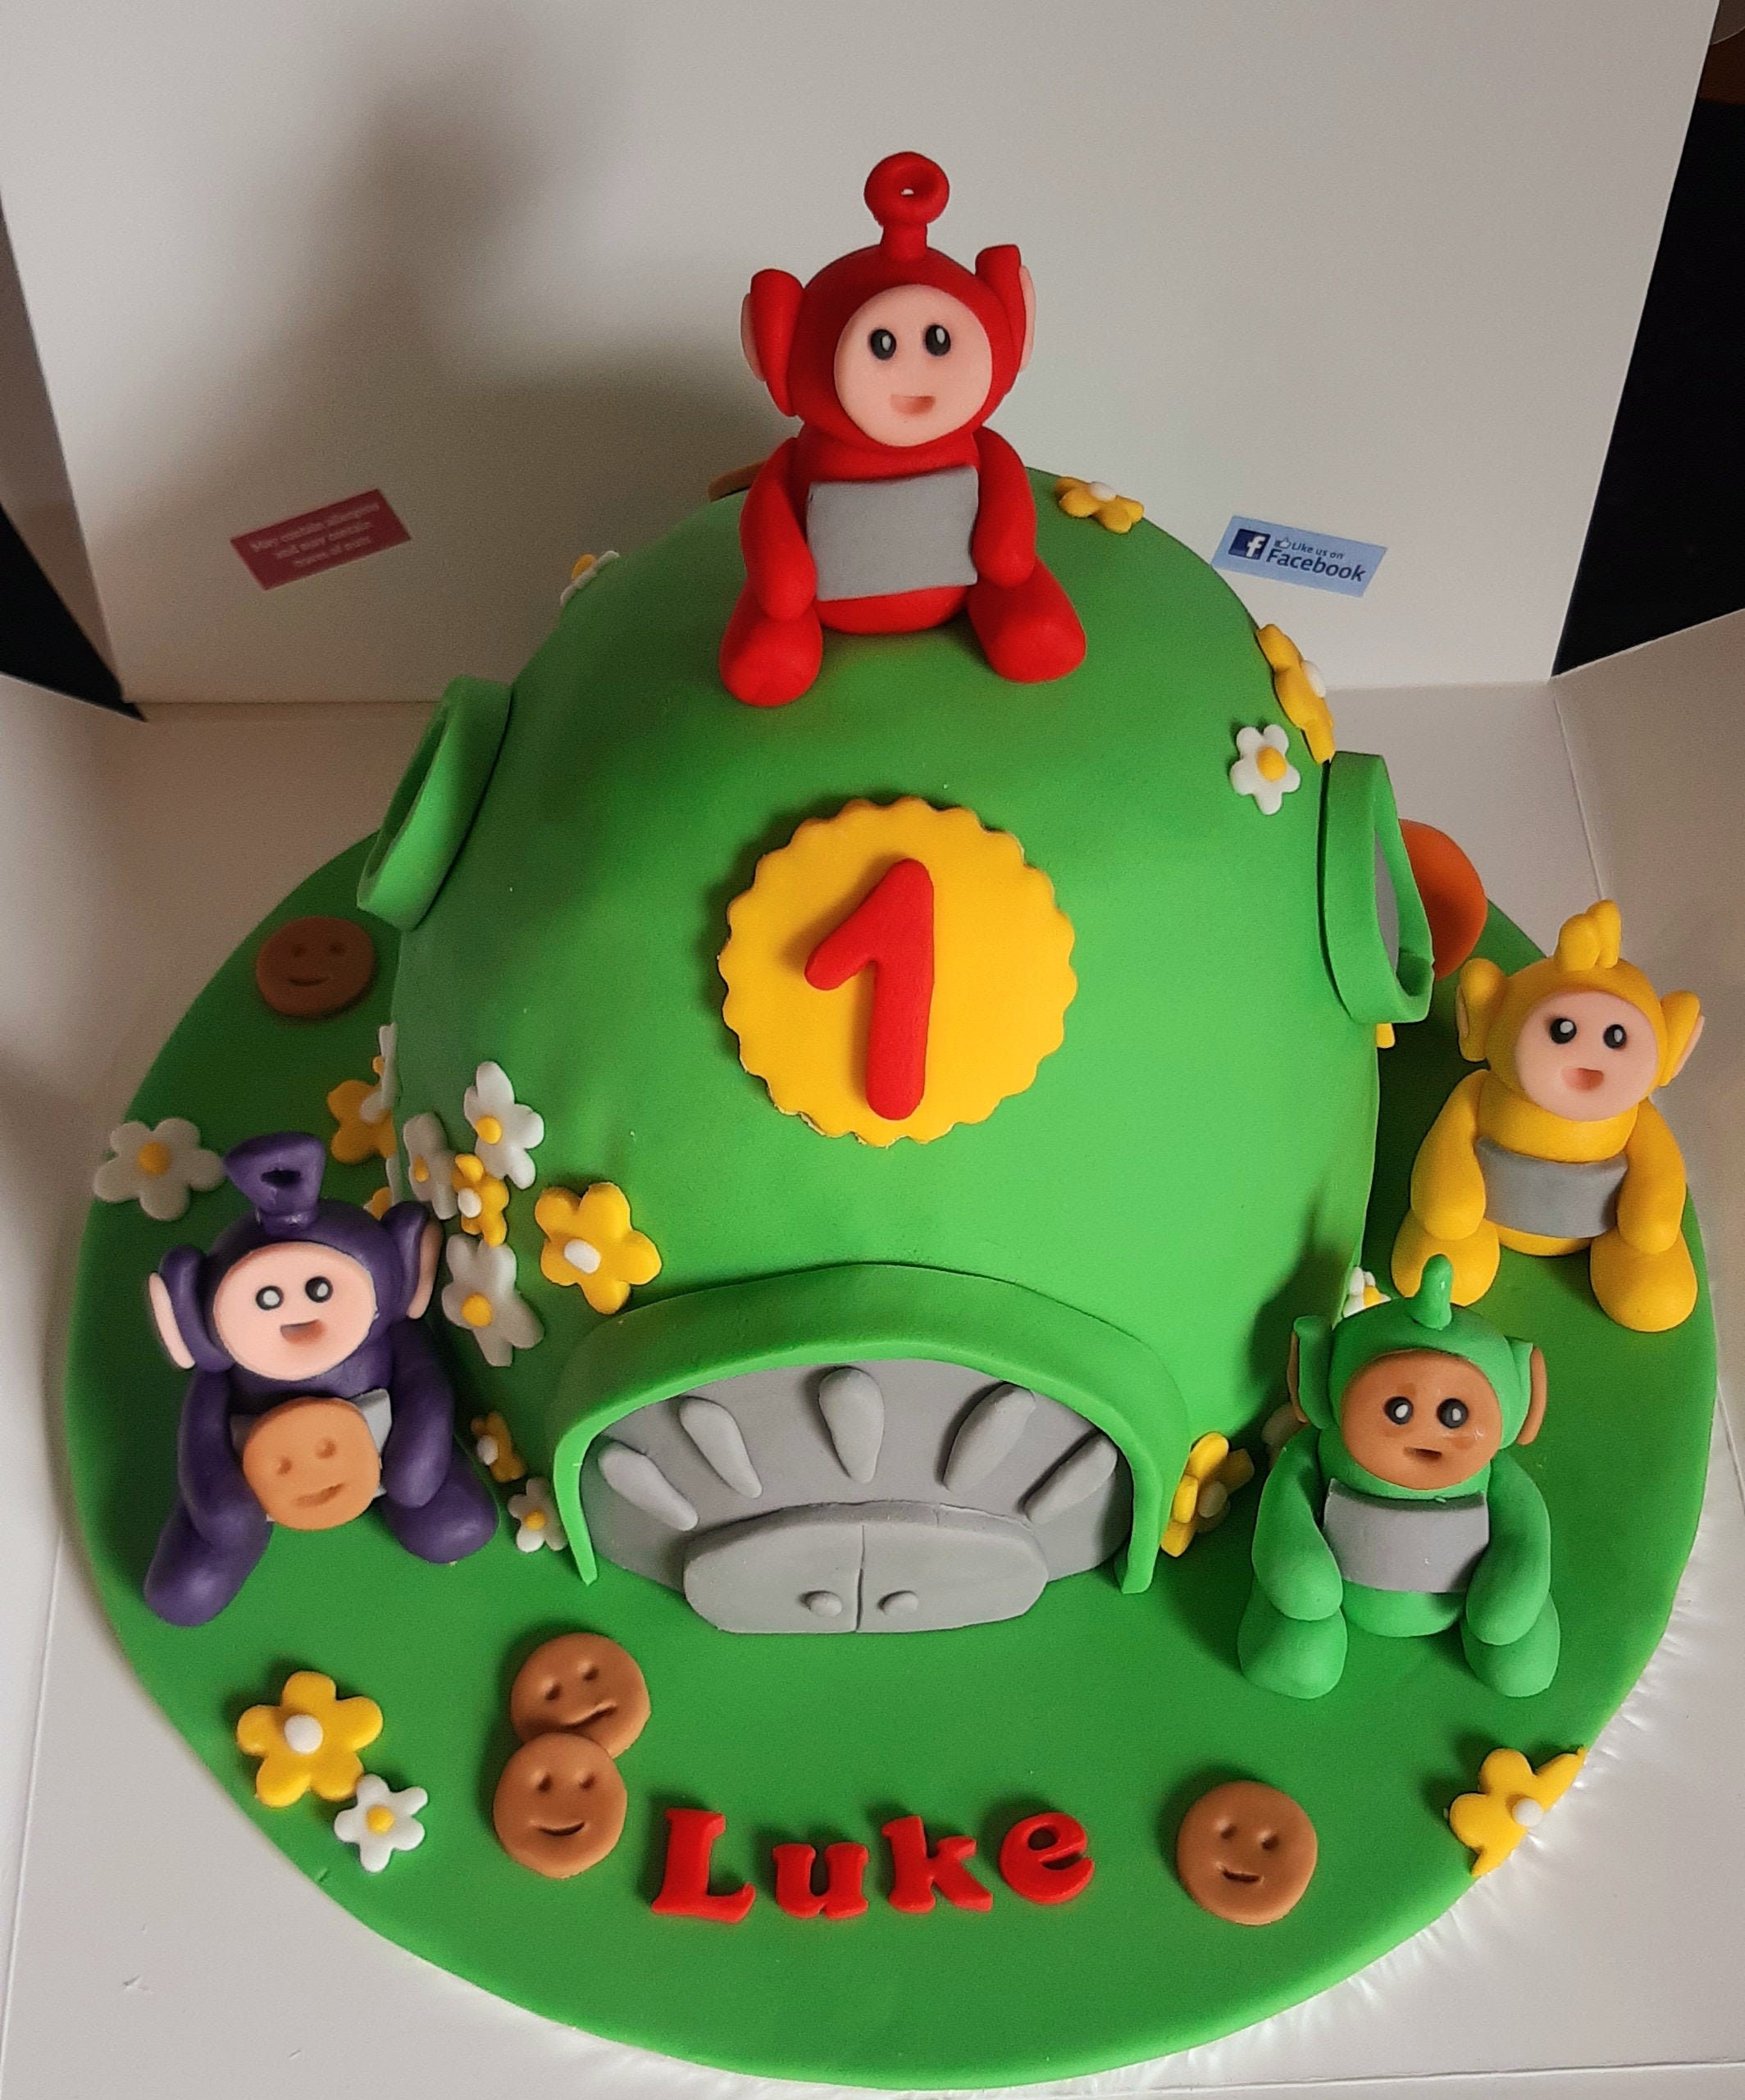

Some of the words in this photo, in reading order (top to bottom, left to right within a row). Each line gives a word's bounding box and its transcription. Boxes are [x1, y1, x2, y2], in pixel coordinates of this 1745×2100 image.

[1266, 549, 1366, 581] Facebook
[1292, 543, 1313, 553] Like
[1316, 549, 1328, 557] us
[804, 858, 934, 1121] 1
[651, 1808, 1095, 1924] Luke
